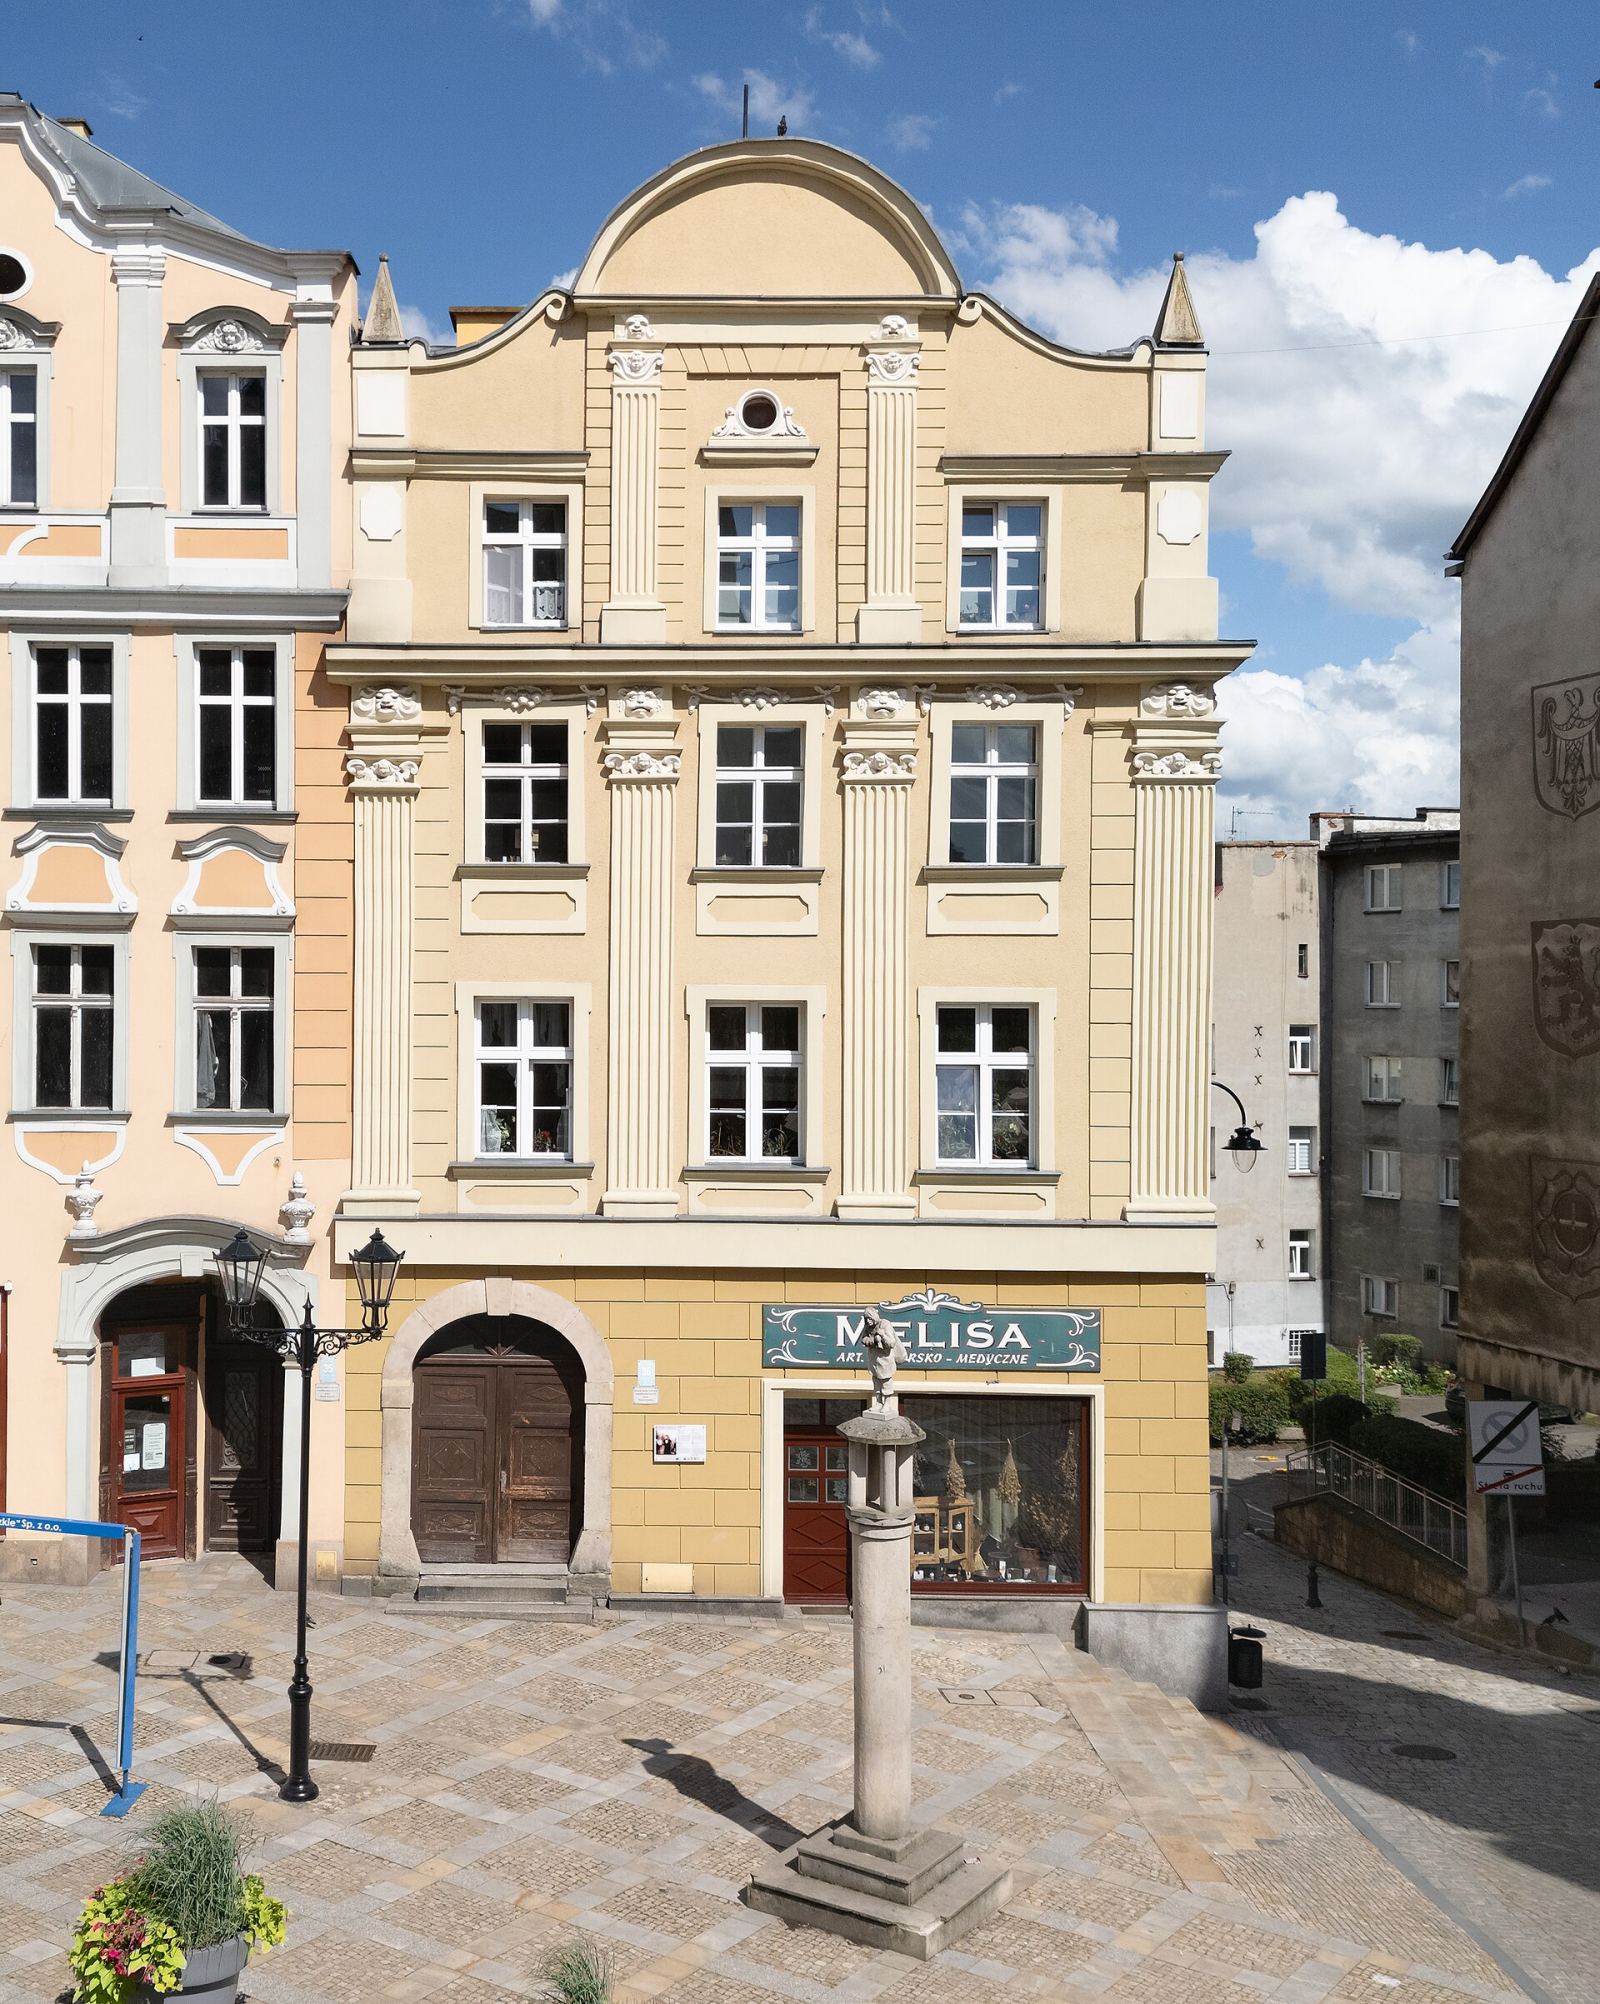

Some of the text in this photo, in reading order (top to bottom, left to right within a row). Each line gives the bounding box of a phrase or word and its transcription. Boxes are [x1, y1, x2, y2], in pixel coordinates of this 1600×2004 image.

[836, 1315, 1031, 1349] MELISA
[836, 1352, 864, 1362] ART.
[1478, 1481, 1543, 1490] Sta ruchu
[21, 1519, 35, 1530] Sp.
[44, 1523, 62, 1531] o.o.
